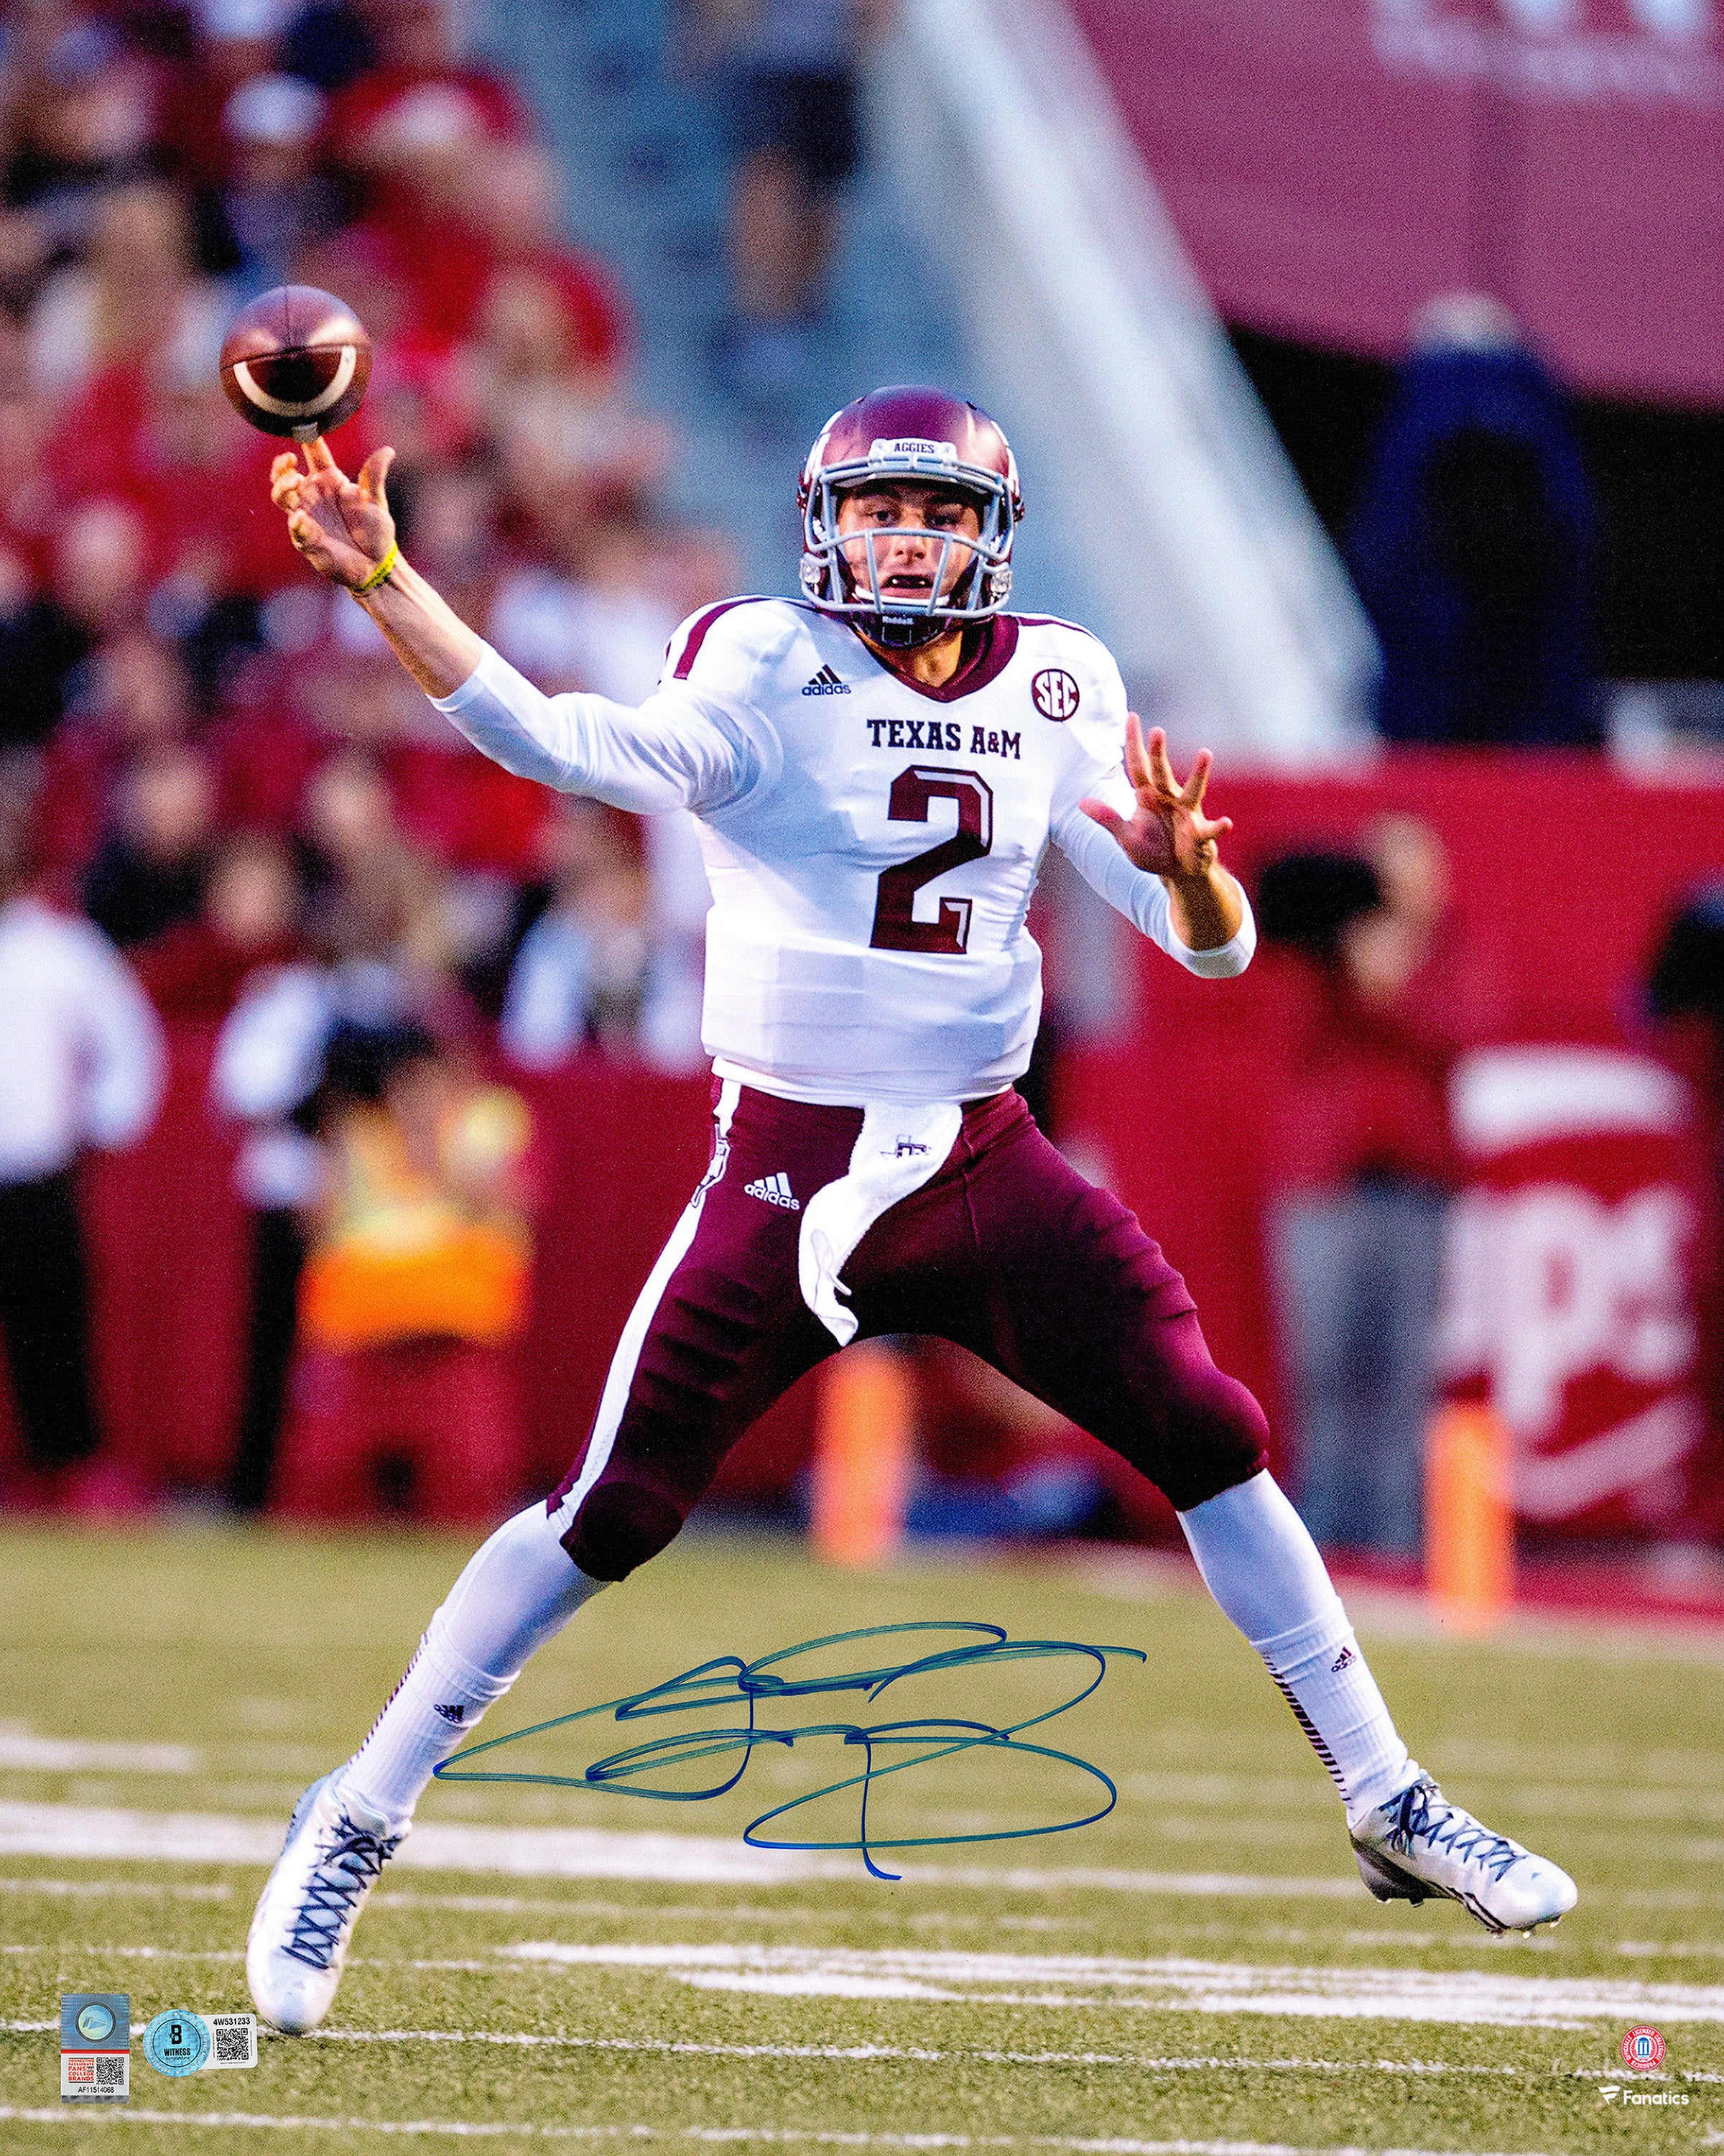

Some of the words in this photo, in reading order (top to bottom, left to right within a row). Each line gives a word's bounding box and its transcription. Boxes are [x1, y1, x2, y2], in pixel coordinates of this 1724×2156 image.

[894, 443, 935, 454] AGGIES
[802, 682, 851, 696] adidas
[1037, 670, 1078, 719] SEC
[867, 718, 962, 751] TEXAS
[970, 726, 1021, 759] A&M
[869, 764, 993, 954] 2
[744, 1183, 800, 1211] adidas
